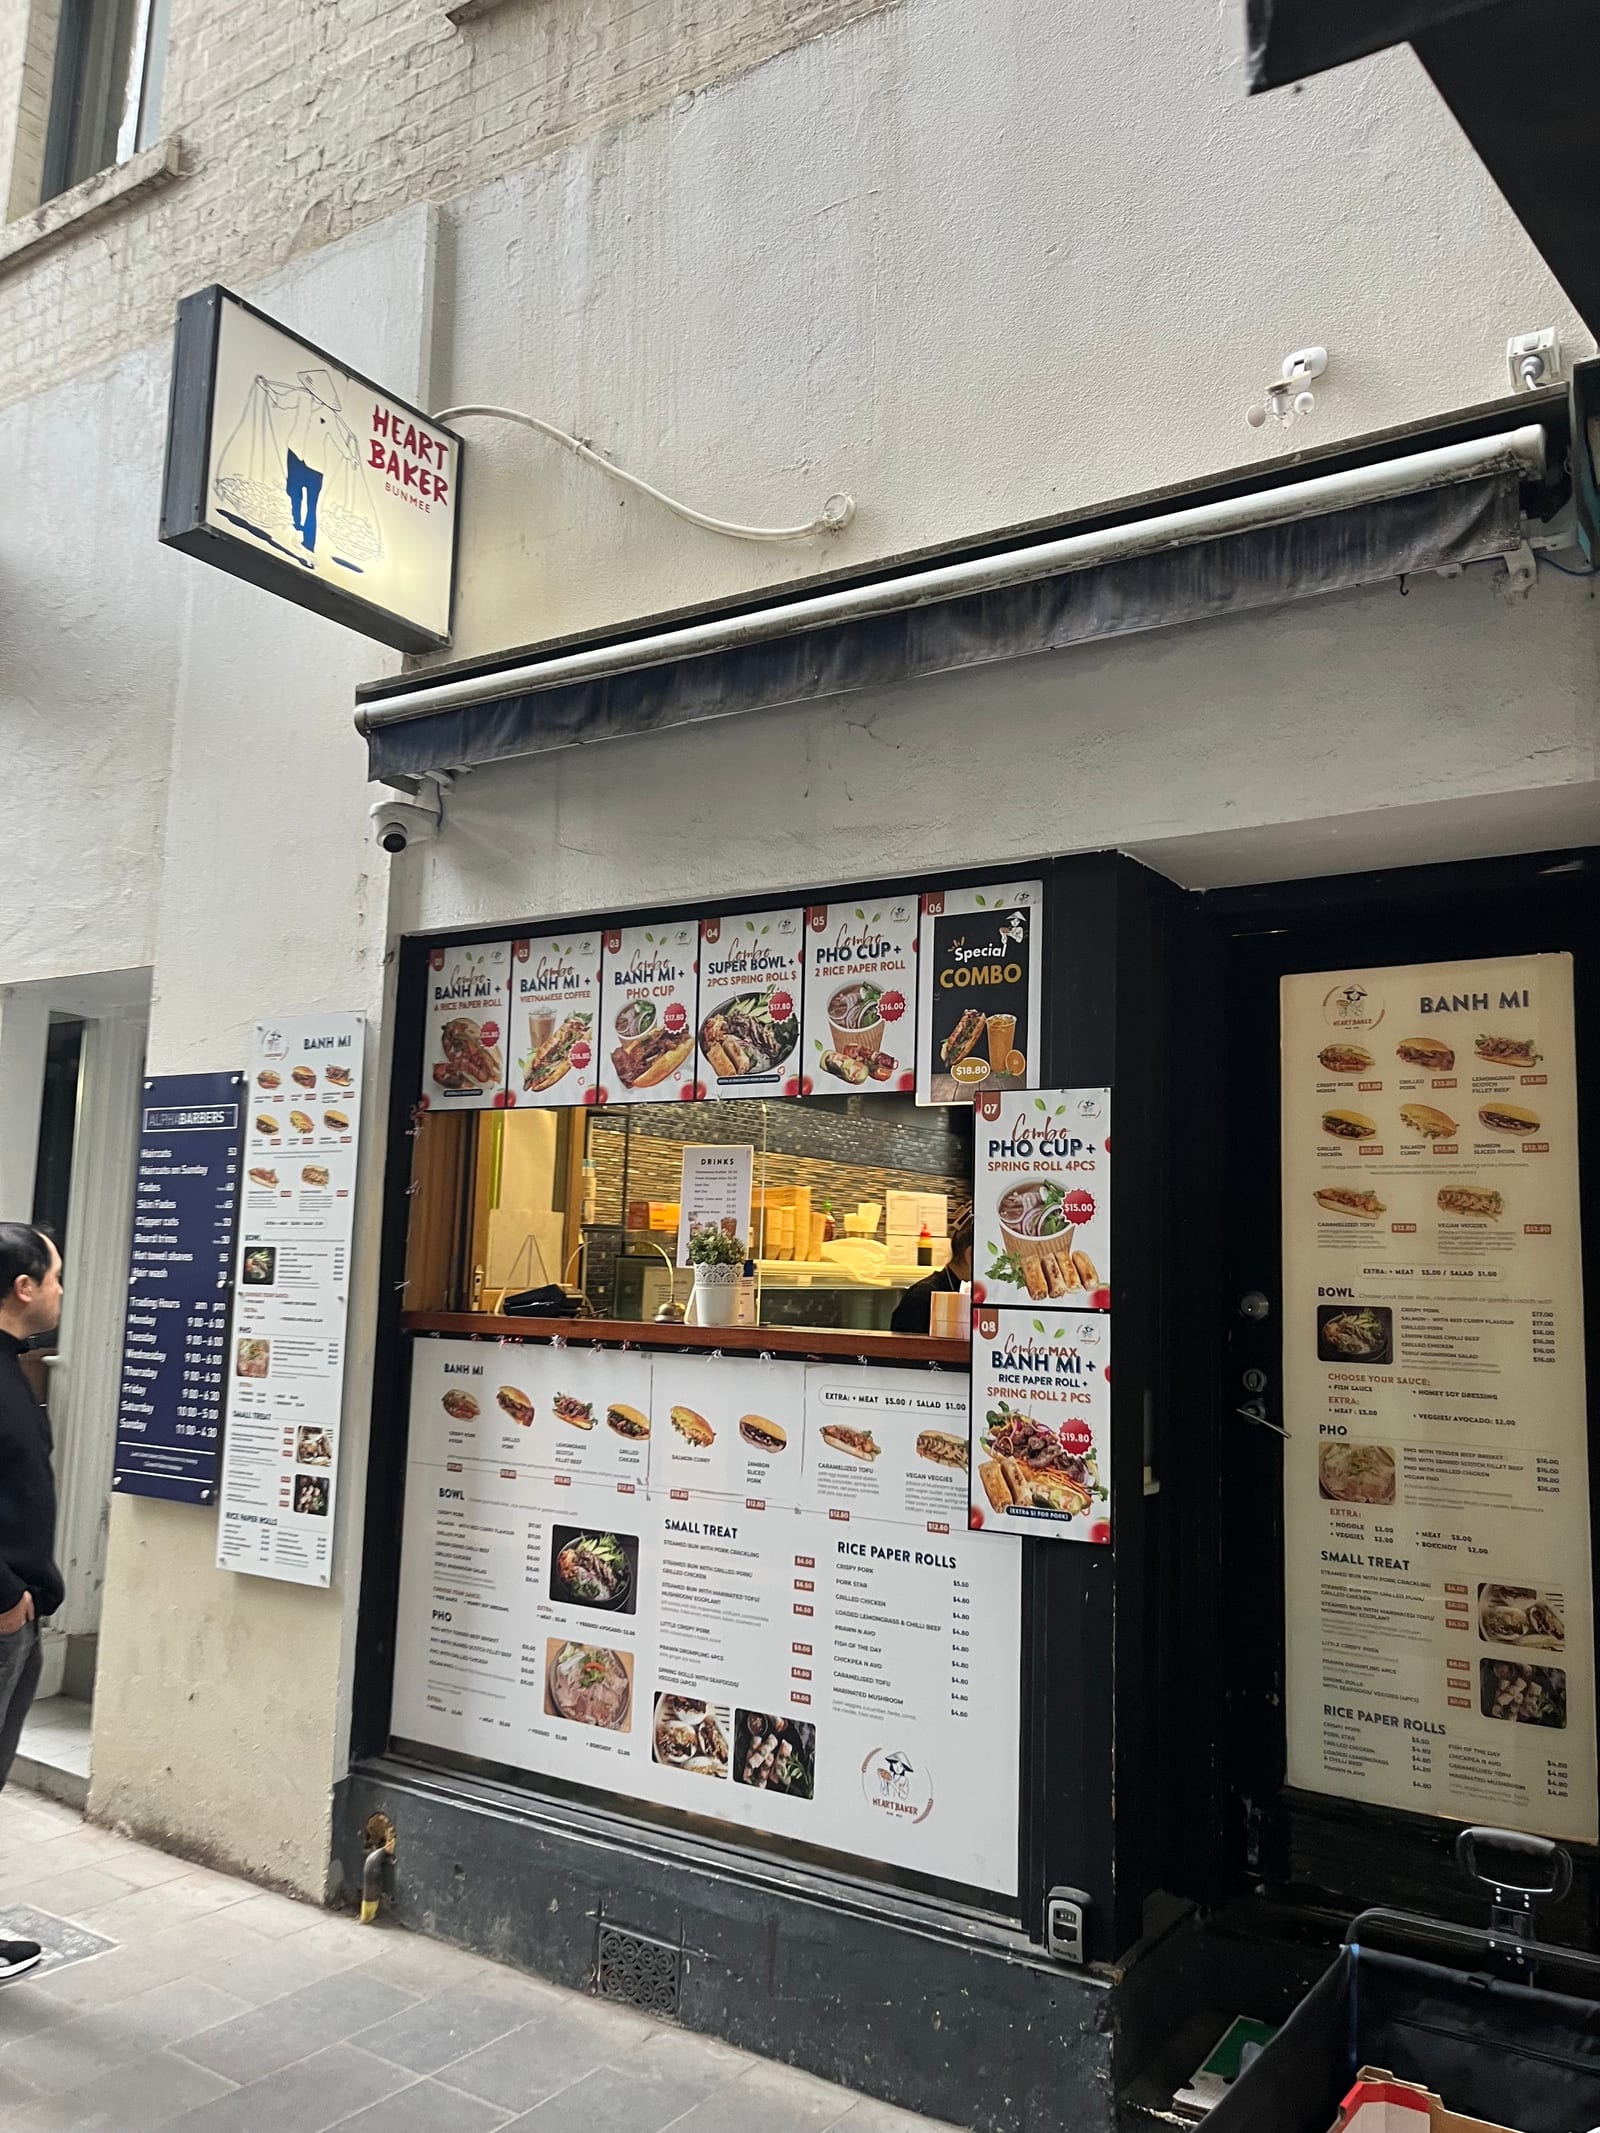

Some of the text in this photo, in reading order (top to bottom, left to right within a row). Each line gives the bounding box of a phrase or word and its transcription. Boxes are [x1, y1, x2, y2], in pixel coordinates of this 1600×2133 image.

[372, 404, 449, 470] HEART
[367, 439, 449, 506] BAKER
[385, 482, 431, 514] BUNMEE
[929, 903, 941, 912] 06
[812, 916, 825, 926] 05
[707, 929, 718, 938] 04
[836, 923, 884, 950] Combo
[609, 939, 619, 948] 03
[728, 938, 771, 961] Combo
[816, 947, 854, 964] PHO
[857, 942, 891, 958] CUP
[954, 944, 1007, 963] Special
[630, 949, 670, 972] Combo
[709, 959, 746, 974] SUPER
[750, 956, 786, 970] BOWL
[537, 956, 574, 980] Combo
[815, 960, 906, 977] 2 RICE PAPER ROLL
[520, 975, 557, 992] BANH
[563, 974, 580, 988] MI
[615, 970, 654, 985] BANH
[659, 967, 675, 981] MI
[707, 972, 788, 987] 2PCS SPRING ROLL
[940, 964, 1022, 988] COMBO
[435, 984, 470, 1000] BANH
[520, 991, 591, 1003] VIETNAMESE COFFEE
[627, 985, 675, 999] PHO CUP
[441, 1002, 457, 1010] RICE
[459, 1001, 481, 1009] PAPER
[880, 1002, 904, 1011] $16.00
[1420, 990, 1529, 1014] BANH MI
[304, 1036, 351, 1050] BANH MI
[957, 1066, 988, 1076] $18.80
[984, 1103, 998, 1114] 07
[1012, 1113, 1071, 1143] Combo
[988, 1140, 1033, 1158] PHO
[1039, 1138, 1083, 1157] CUP
[988, 1161, 1095, 1171] SPRING ROLL 4PCS
[1065, 1204, 1092, 1212] $15.00
[1318, 1287, 1355, 1298] BOWL
[981, 1320, 996, 1332] 08
[1004, 1333, 1077, 1358] Combo MAX
[444, 1363, 484, 1375] BANH MI
[992, 1351, 1048, 1372] BANH
[1056, 1356, 1081, 1374] MI
[999, 1374, 1020, 1384] RICE
[1023, 1375, 1052, 1386] PAPER
[1055, 1377, 1080, 1388] ROLL
[1328, 1373, 1430, 1386] CHOOSE YOUR SAUCE:
[123, 1383, 147, 1396] Friday
[987, 1387, 1091, 1403] SPRING ROLL 2 PCS
[825, 1392, 966, 1410] EXTRA: MEAT $5.00 SALAD $1.00
[1328, 1397, 1360, 1405] EXTRA:
[1319, 1424, 1347, 1436] PHO
[1061, 1433, 1089, 1443] $19.80
[906, 1472, 953, 1483] VEGAN VEGGIES
[439, 1488, 465, 1500] BOWL
[665, 1519, 738, 1539] SMALL TREAT
[1336, 1522, 1364, 1530] NOODLE
[1336, 1532, 1364, 1541] VEGGIES
[838, 1542, 956, 1569] RICE PAPER ROLLS
[1321, 1551, 1410, 1571] SMALL TREAT
[836, 1594, 886, 1607] GRILLED CHICKEN
[432, 1609, 452, 1622] PHO
[906, 1621, 925, 1629] CHILLI
[834, 1656, 862, 1665] CHICKPEA
[868, 1693, 903, 1704] MUSHROOM
[1323, 1705, 1446, 1735] RICE PAPER ROLLS
[872, 1797, 893, 1809] HEART
[894, 1802, 918, 1815] BAKER
